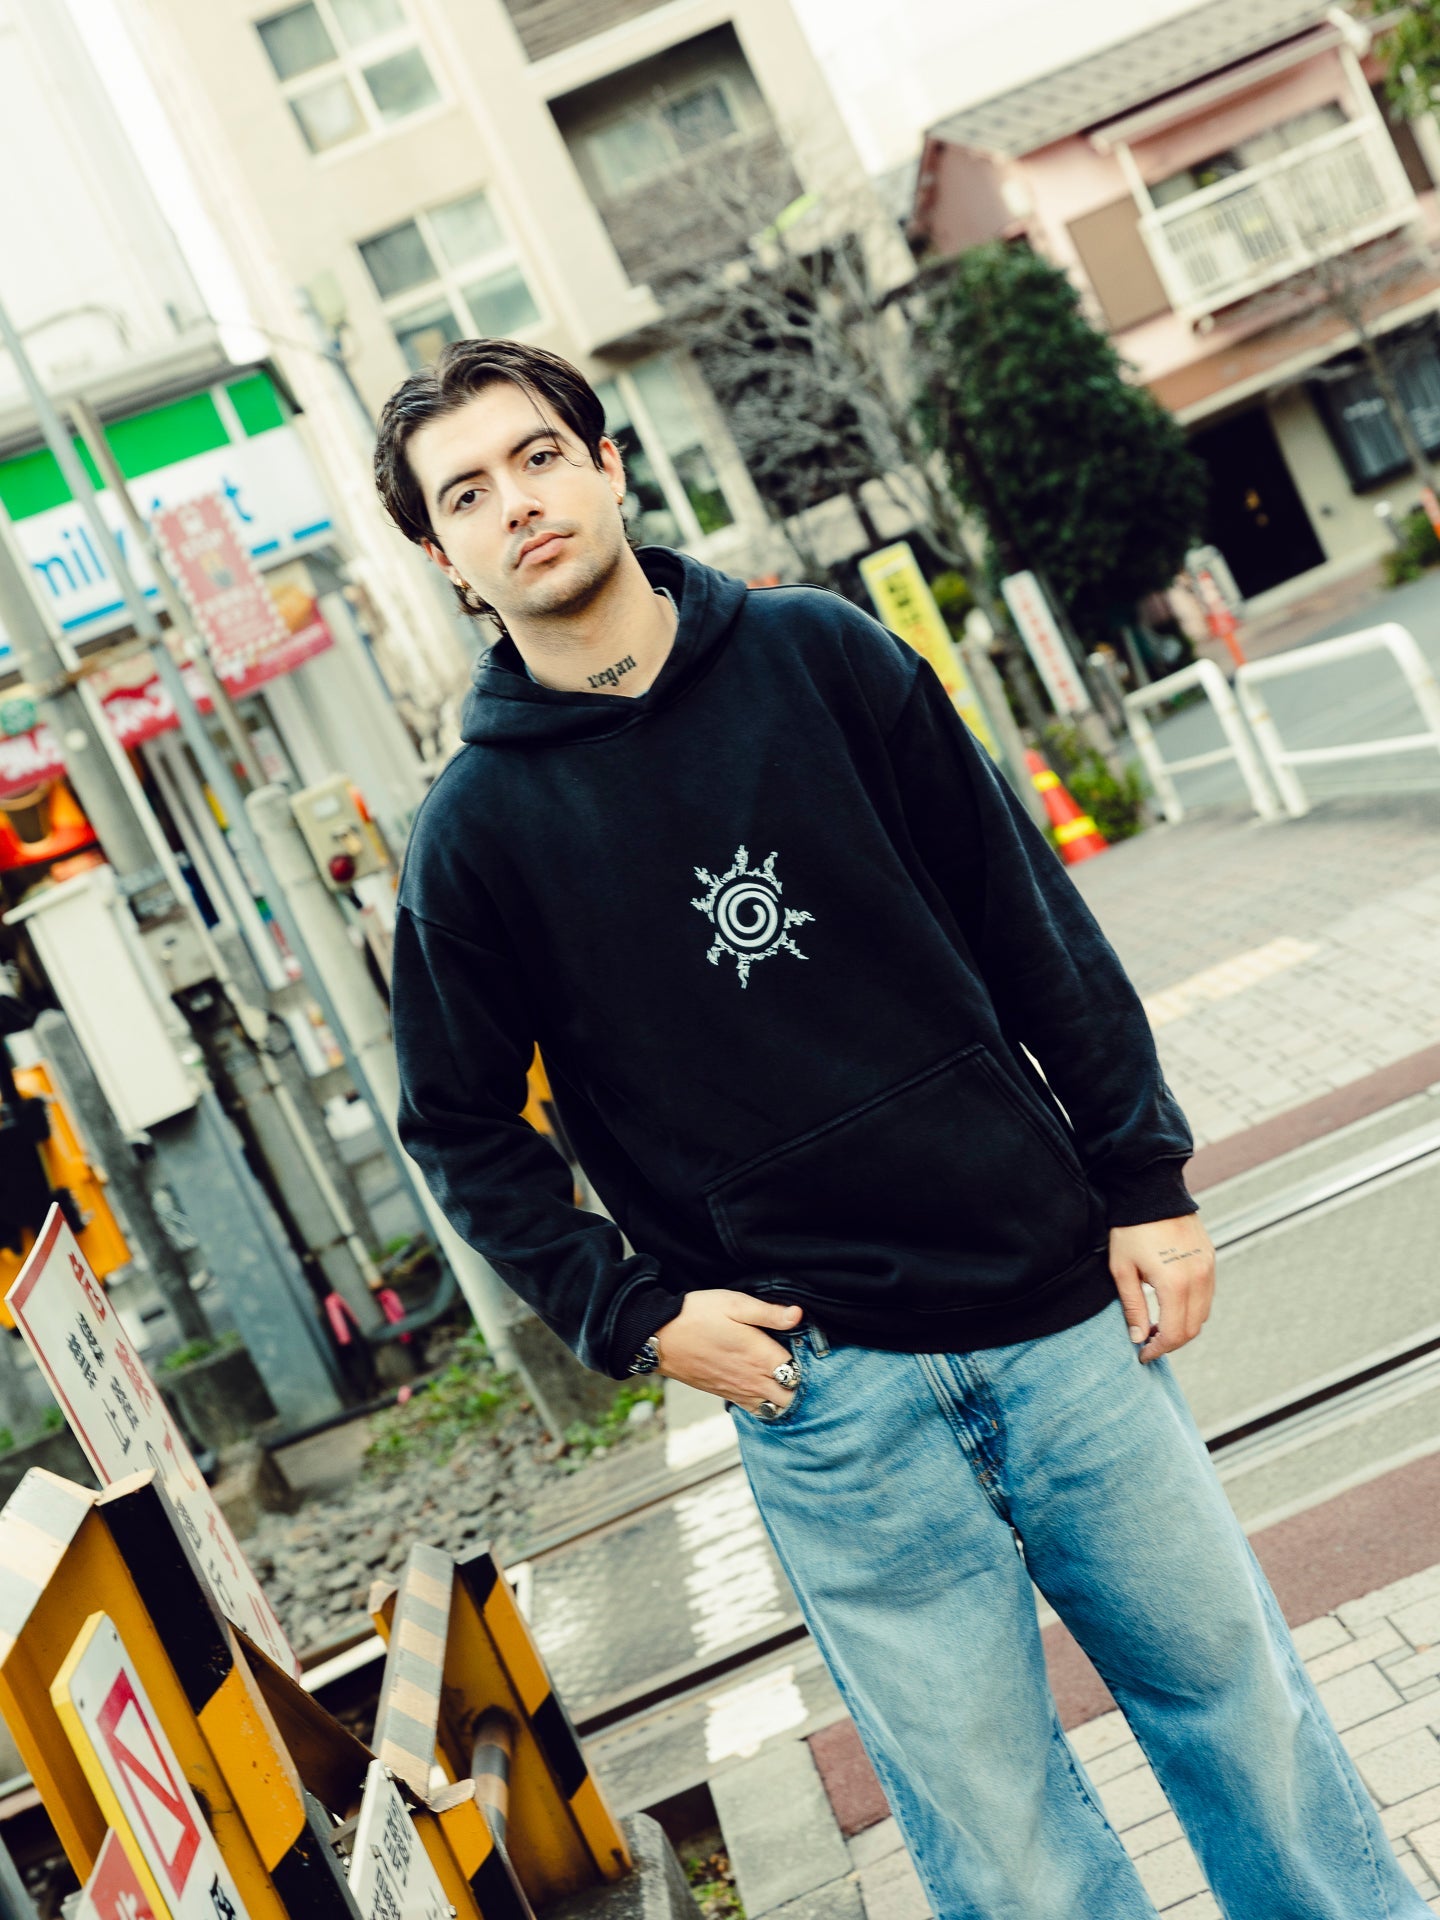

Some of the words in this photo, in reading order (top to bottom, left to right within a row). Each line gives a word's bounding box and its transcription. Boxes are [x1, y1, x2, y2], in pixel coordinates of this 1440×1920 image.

[66, 1331, 140, 1472] 禁止
[76, 1311, 247, 1634] 線路の通行
